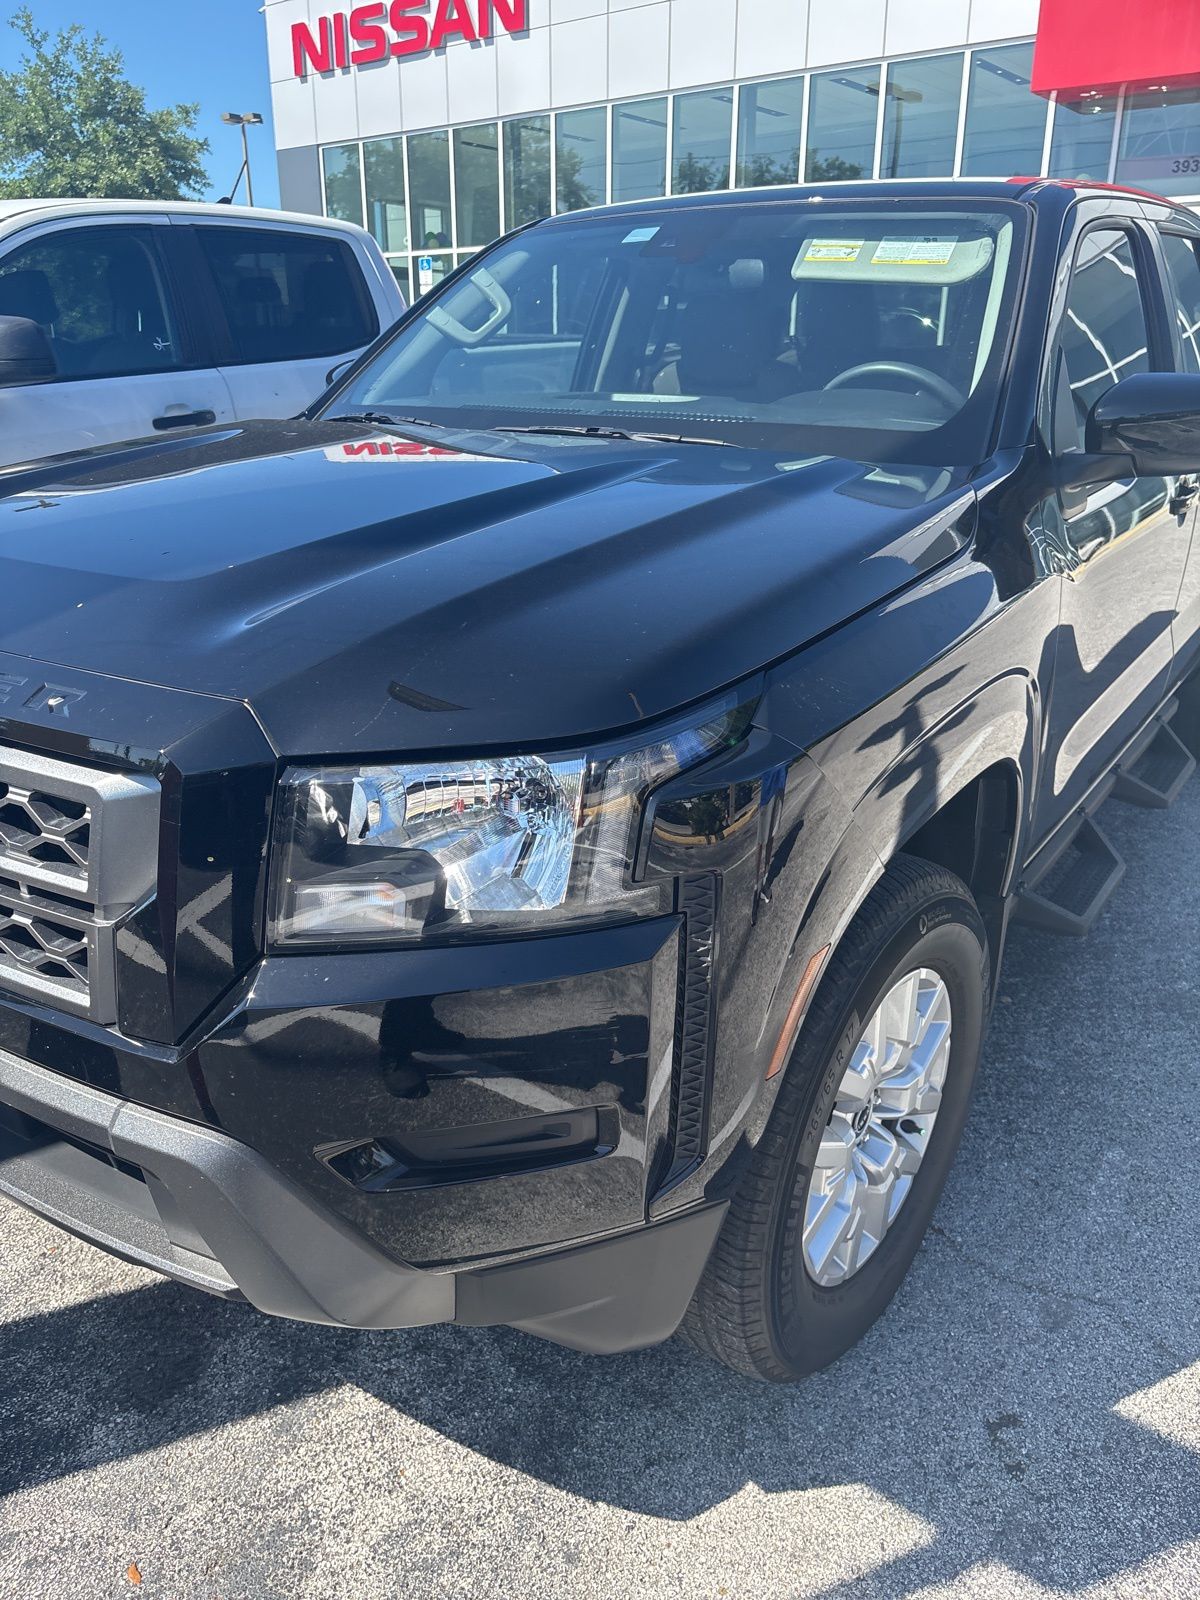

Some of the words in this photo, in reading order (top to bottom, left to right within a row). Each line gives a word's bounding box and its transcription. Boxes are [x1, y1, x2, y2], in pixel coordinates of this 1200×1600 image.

[291, 0, 525, 77] NISSAN
[1171, 159, 1200, 173] 393
[807, 1069, 835, 1145] 265/65
[835, 1049, 845, 1066] R
[845, 1023, 855, 1046] 17
